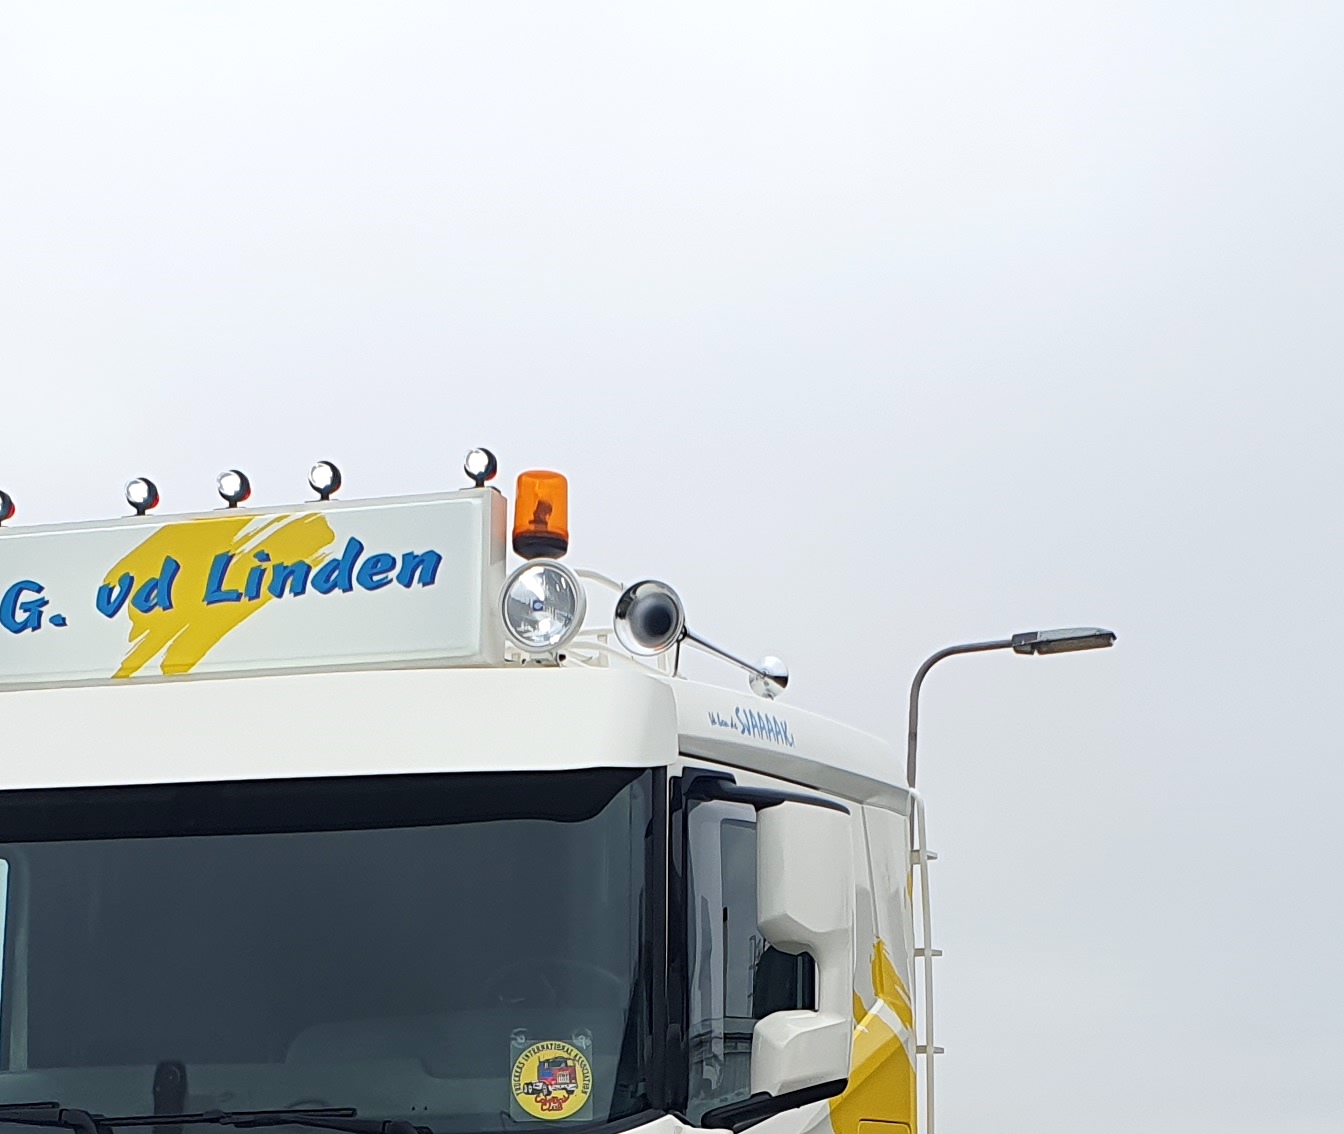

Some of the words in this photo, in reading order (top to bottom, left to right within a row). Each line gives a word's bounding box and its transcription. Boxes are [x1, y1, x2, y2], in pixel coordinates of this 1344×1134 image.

[95, 555, 181, 618] vd
[201, 536, 443, 606] Linden
[522, 1042, 572, 1062] INTERNATIONAL
